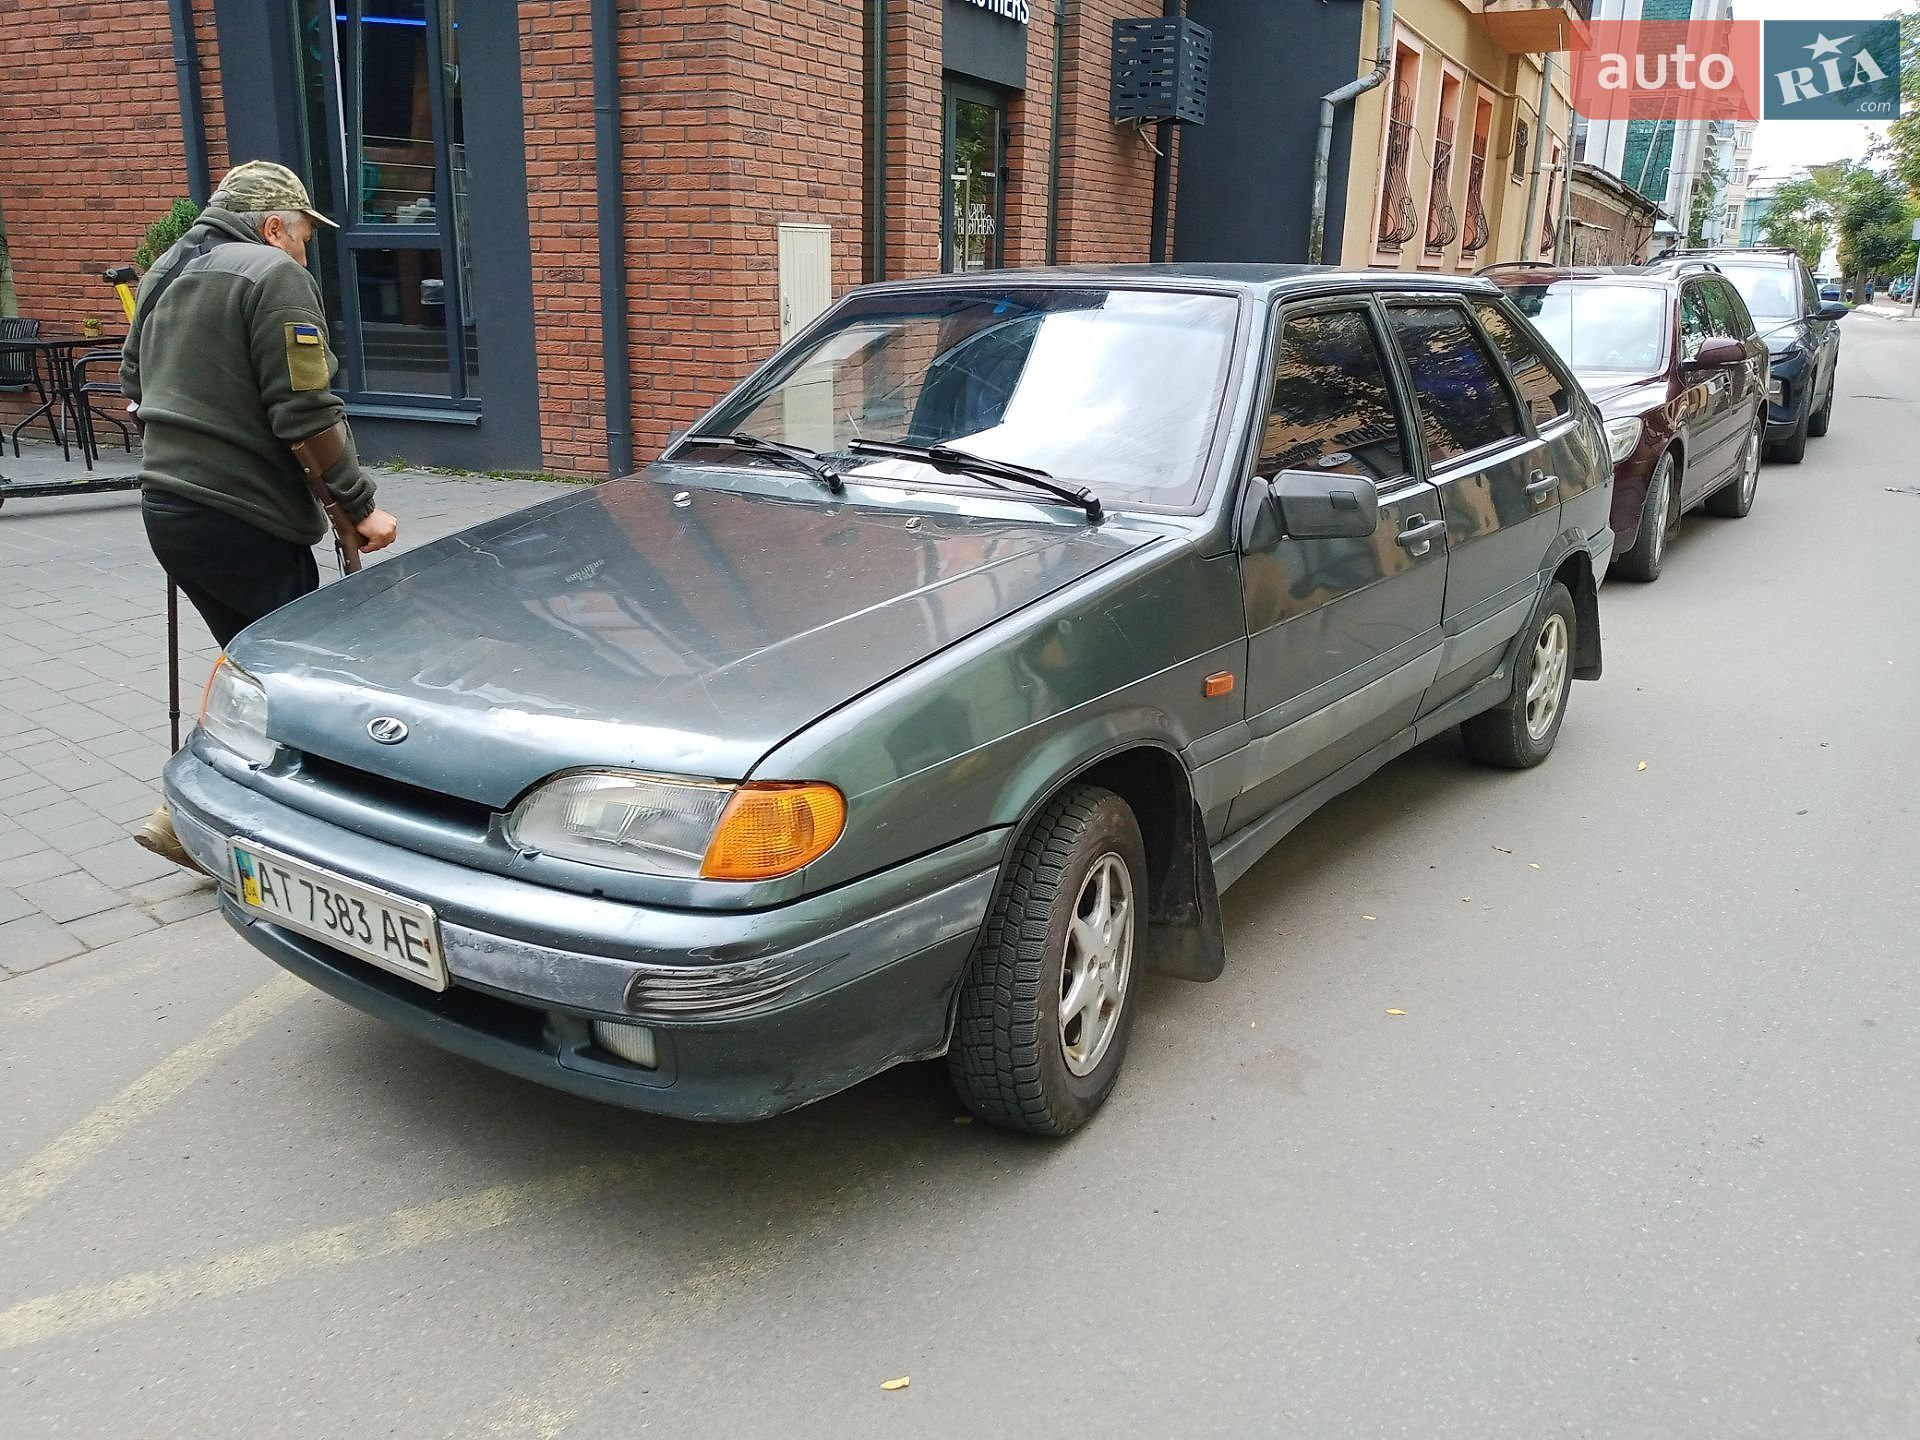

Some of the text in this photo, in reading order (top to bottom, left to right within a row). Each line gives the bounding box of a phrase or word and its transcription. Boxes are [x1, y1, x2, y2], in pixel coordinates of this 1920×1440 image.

[258, 862, 429, 968] AT 7383 AE
